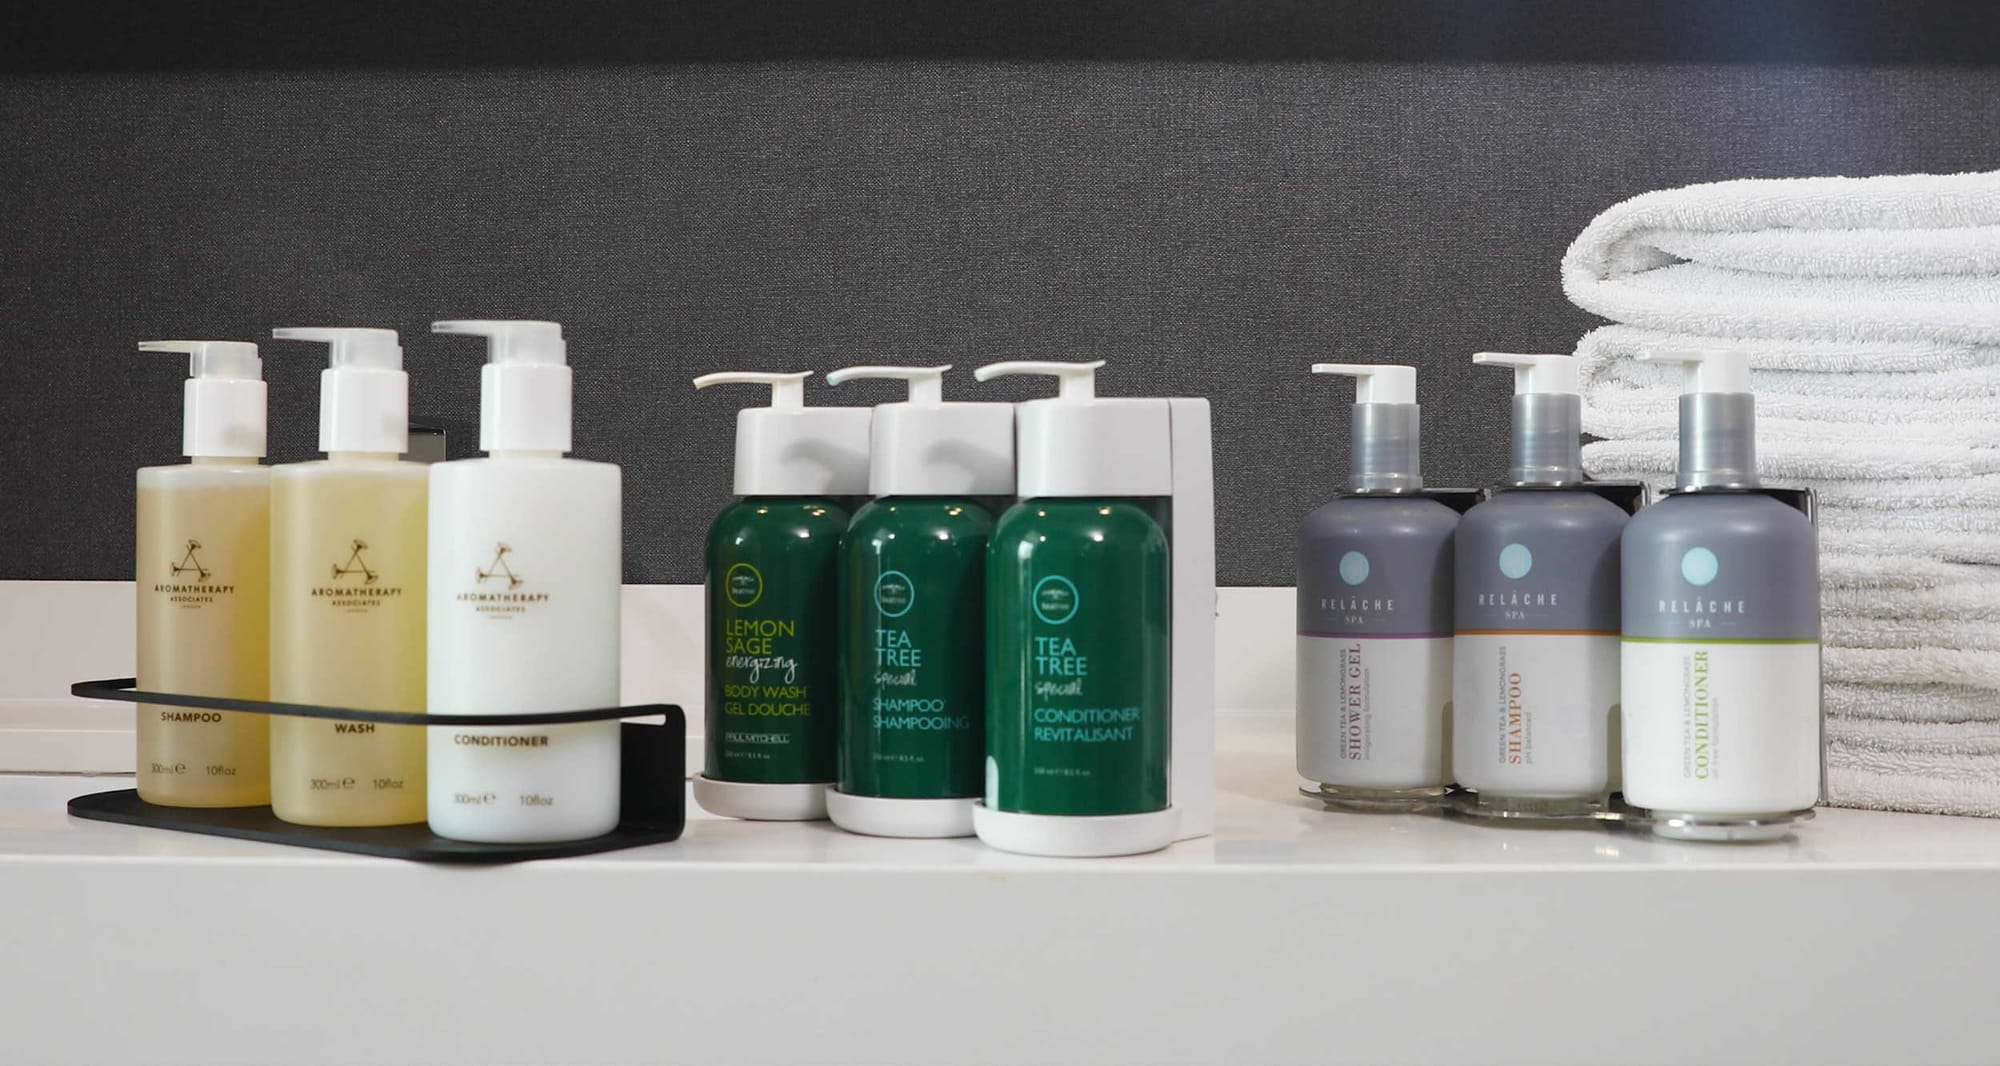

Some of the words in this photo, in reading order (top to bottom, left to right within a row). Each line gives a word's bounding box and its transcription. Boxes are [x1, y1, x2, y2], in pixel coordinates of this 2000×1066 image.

[154, 584, 235, 594] AROMATHERAPY
[311, 587, 402, 597] AROMATHERAPY
[456, 593, 550, 602] AROMATHERAPY
[1344, 615, 1365, 625] SPA
[1504, 610, 1525, 620] SPA
[726, 619, 795, 637] LEMON
[1689, 619, 1711, 629] SPA
[726, 637, 773, 655] SAGE
[875, 629, 912, 648] TEA
[1034, 636, 1077, 656] TEA
[875, 648, 921, 667] TREE
[1349, 643, 1361, 678] GEL
[726, 655, 798, 684] energizing
[1034, 656, 1088, 676] TREE
[874, 668, 917, 690] special
[724, 684, 760, 698] BODY
[762, 685, 807, 699] WASH
[1034, 676, 1083, 702] special
[724, 701, 746, 716] GEL
[748, 703, 812, 717] DOUCHE
[872, 697, 945, 712] SHAMPOO
[160, 711, 222, 723] SHAMPOO
[873, 715, 970, 730] SHAMPOOING
[1033, 706, 1142, 723] CONDITIONER
[1349, 684, 1361, 761] SHOWER
[1509, 672, 1521, 765] SHAMPOO
[1695, 651, 1708, 780] CONDITIONER
[334, 722, 375, 734] WASH
[1034, 726, 1135, 742] REVITALISANT
[454, 734, 550, 747] CONDITIONER
